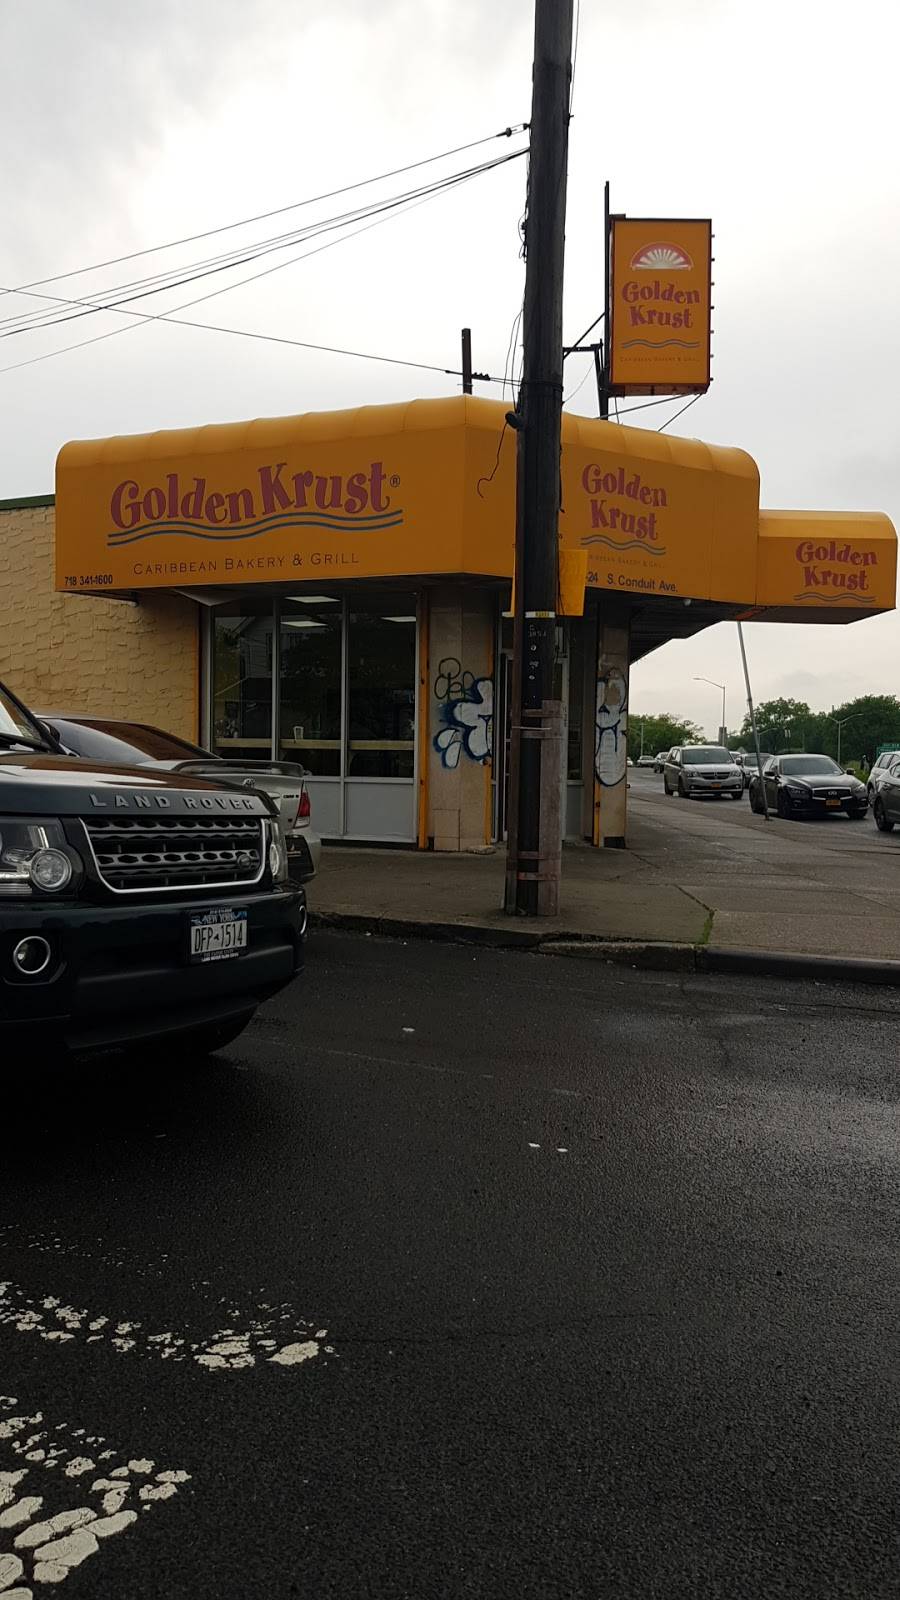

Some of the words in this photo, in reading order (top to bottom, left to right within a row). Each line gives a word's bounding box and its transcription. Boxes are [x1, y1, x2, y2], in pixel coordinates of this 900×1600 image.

[621, 280, 700, 304] Golden
[629, 305, 694, 329] Krust
[582, 463, 668, 508] Golden
[590, 499, 658, 541] Krust
[133, 562, 217, 576] CARIBBEAN
[225, 555, 285, 571] BAKERY
[292, 552, 303, 567] &
[310, 551, 360, 566] GRILL
[795, 541, 878, 566] Golden
[64, 575, 78, 587] 718
[80, 574, 113, 587] 341-1600
[618, 574, 655, 591] Conduit
[803, 565, 870, 591] Krust
[89, 793, 171, 809] LAND
[182, 796, 255, 810] ROVER
